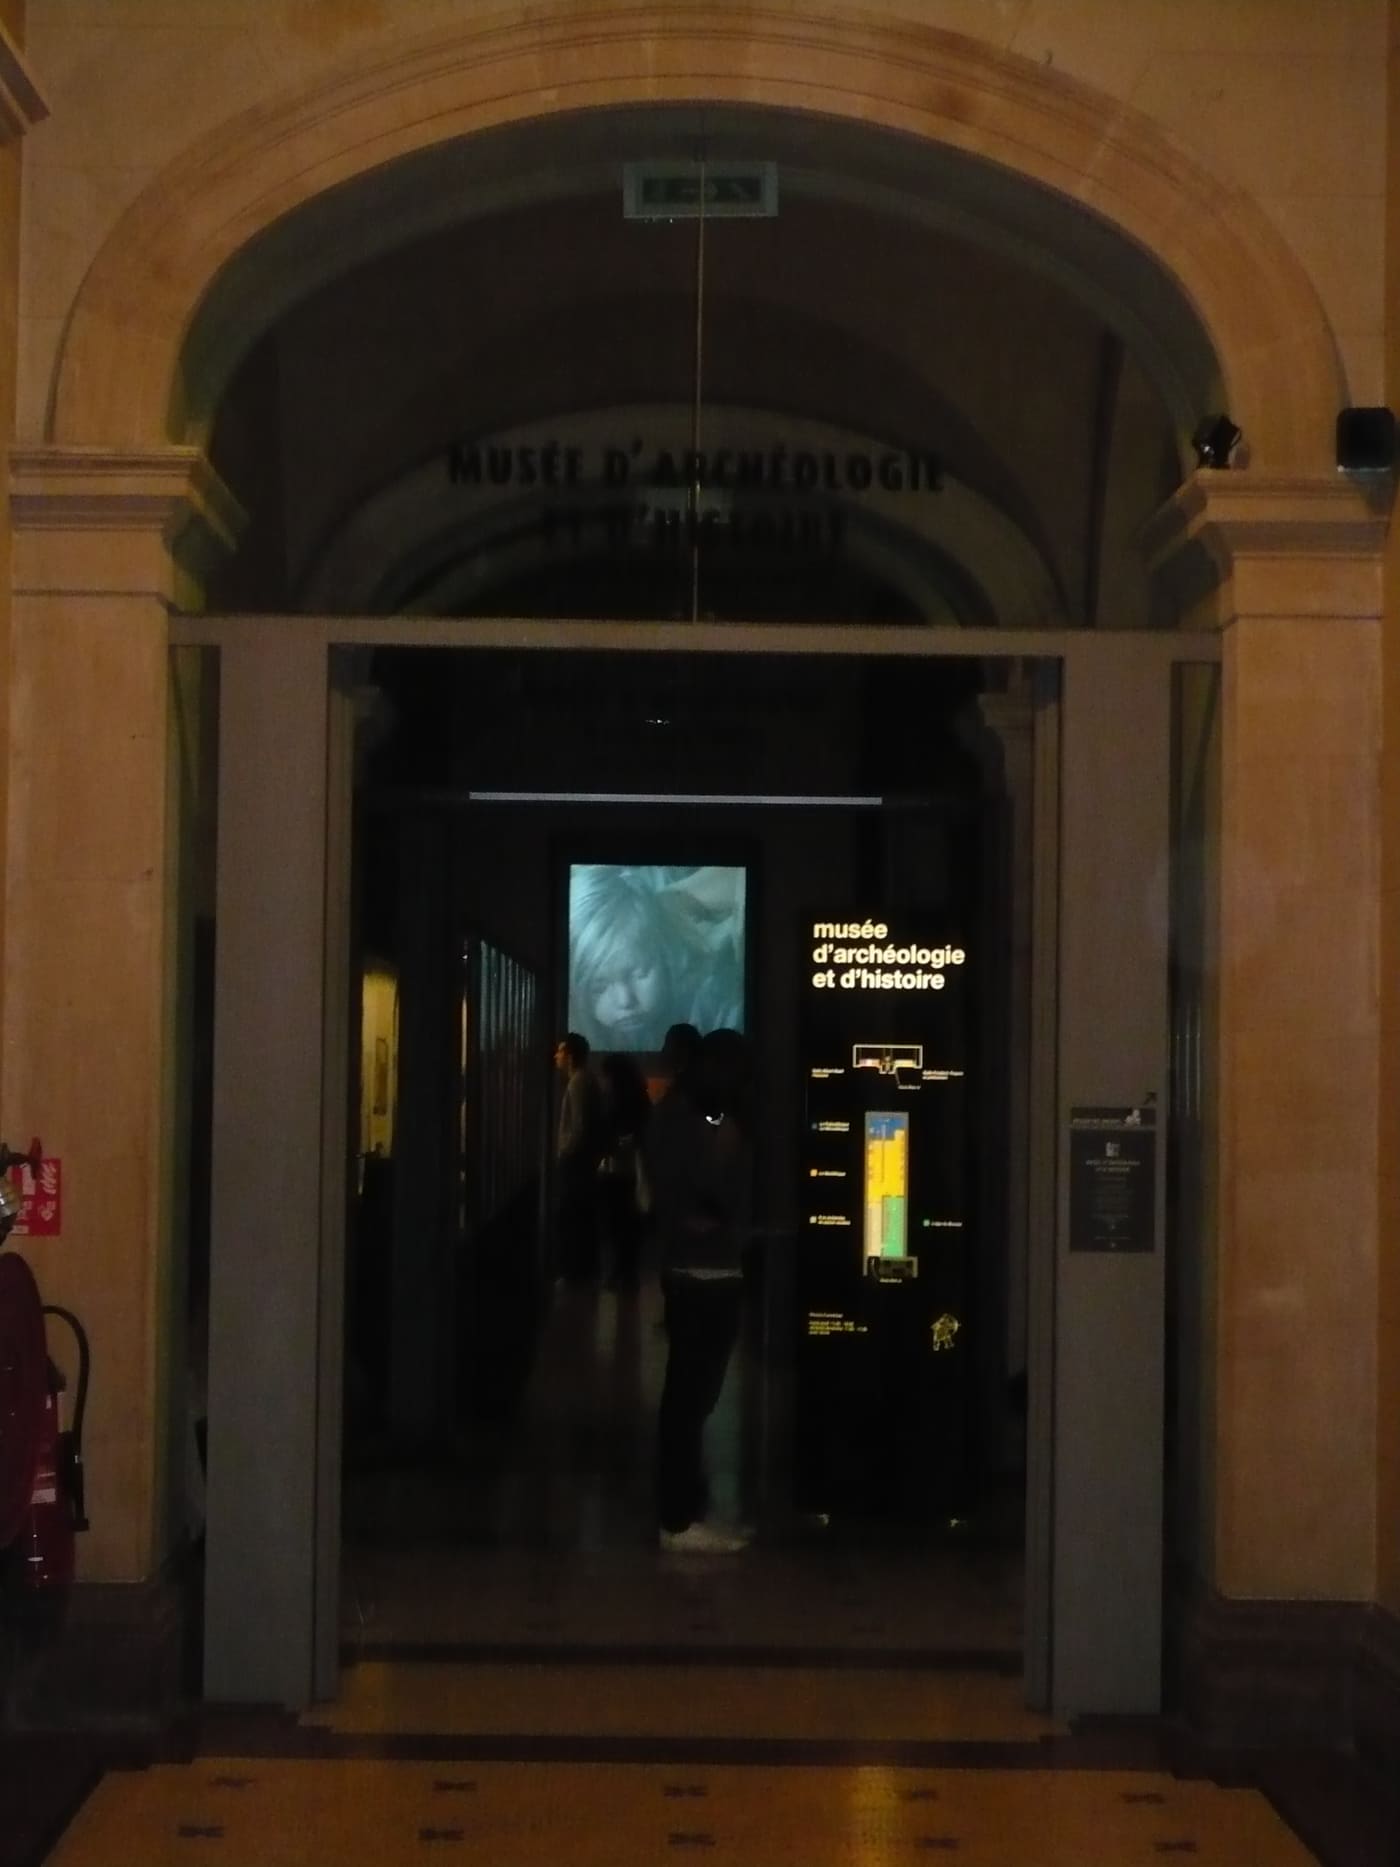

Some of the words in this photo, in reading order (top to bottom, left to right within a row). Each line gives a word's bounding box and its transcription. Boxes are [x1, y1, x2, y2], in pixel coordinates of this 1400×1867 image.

[448, 440, 584, 486] MUSÉE
[813, 919, 889, 939] musée
[812, 943, 966, 969] d'archéologie
[811, 969, 836, 989] et
[840, 968, 946, 990] d'histoire
